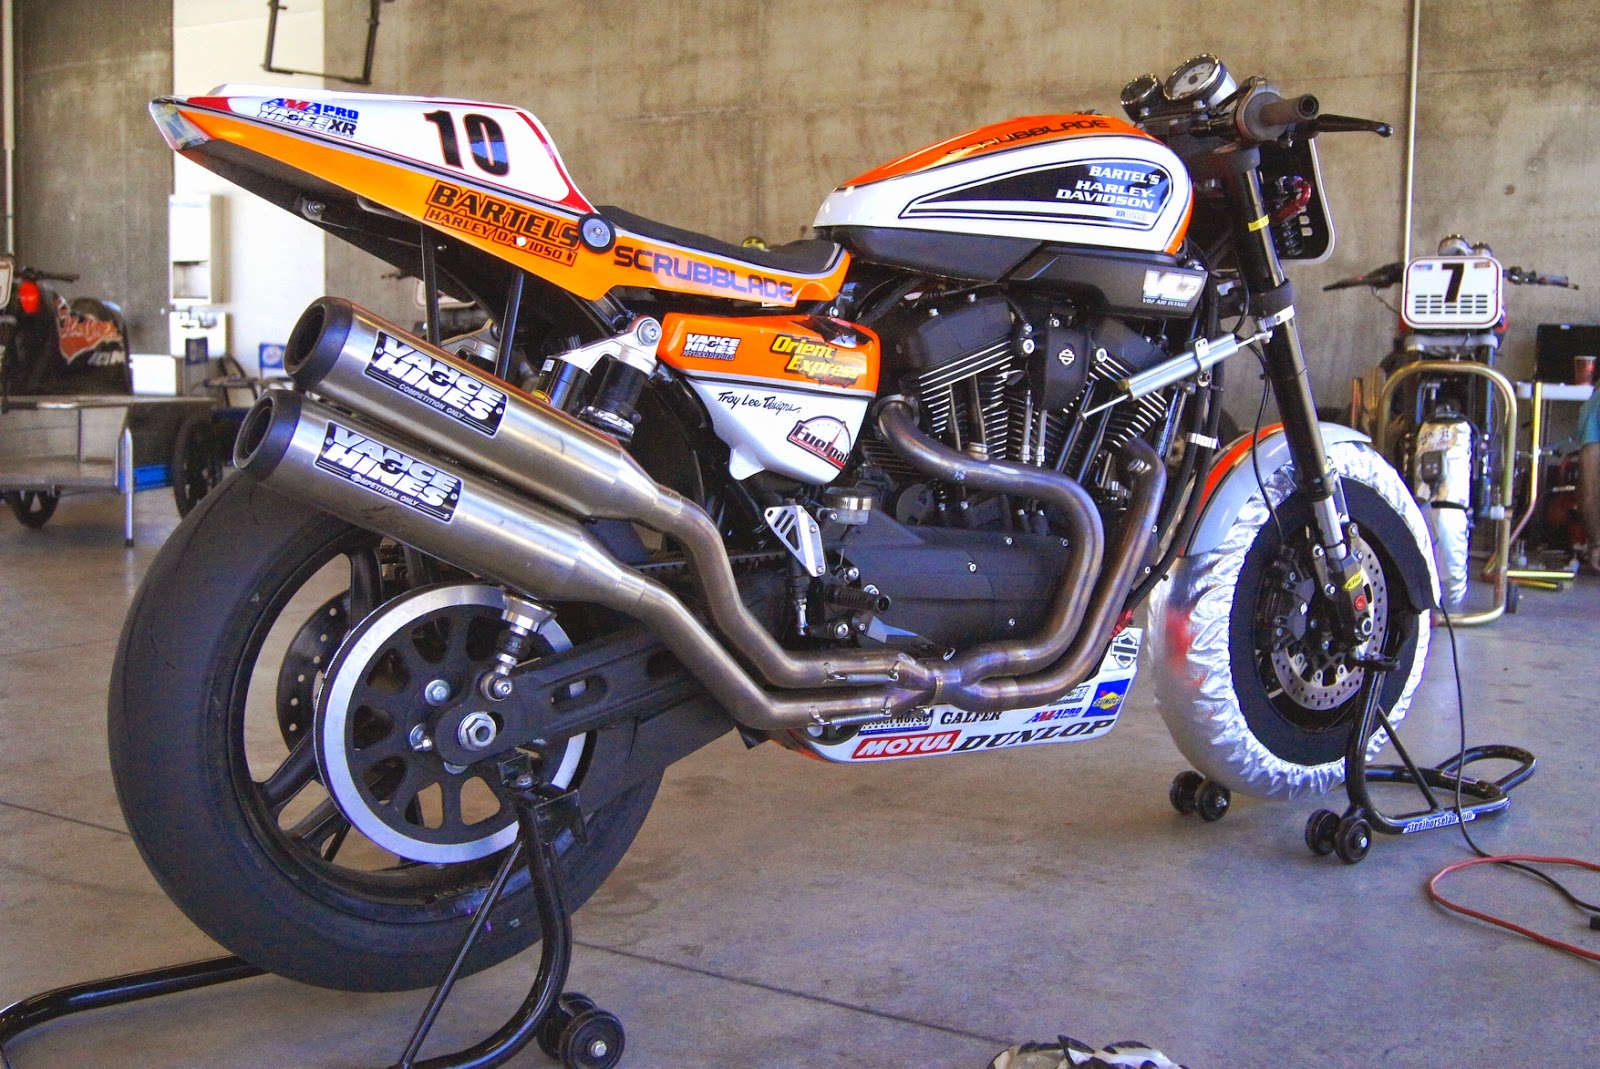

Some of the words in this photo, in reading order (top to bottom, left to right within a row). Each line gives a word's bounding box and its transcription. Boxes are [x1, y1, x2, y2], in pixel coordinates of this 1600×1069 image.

[264, 98, 321, 114] AMA
[323, 105, 359, 120] PRO
[328, 119, 357, 135] XR
[423, 110, 510, 177] 10
[1089, 166, 1160, 185] BARTEL'S
[1056, 189, 1153, 209] DAVIDSON
[1075, 180, 1155, 198] HARLEY-
[428, 208, 493, 239] HARLEY
[613, 245, 794, 302] SCRUBBLADE
[1441, 262, 1465, 303] 7
[684, 342, 737, 355] HINES
[687, 333, 741, 347] VANCE
[772, 336, 835, 359] Orient
[383, 335, 503, 406] VANCE
[787, 354, 860, 379] Express
[373, 353, 493, 420] HINES
[398, 383, 445, 411] COMPETITION
[445, 406, 465, 419] ONLY
[718, 391, 741, 410] Troy
[741, 394, 761, 407] Lee
[333, 426, 458, 493] VANCE
[323, 443, 448, 507] HINES
[351, 473, 399, 499] MPETITION
[400, 494, 419, 507] ONLY
[940, 711, 1002, 725] GALFER
[1023, 709, 1063, 724] AMA
[1062, 707, 1083, 716] PRO
[856, 732, 955, 757] MOTUL
[952, 718, 1116, 752] DUNLOP
